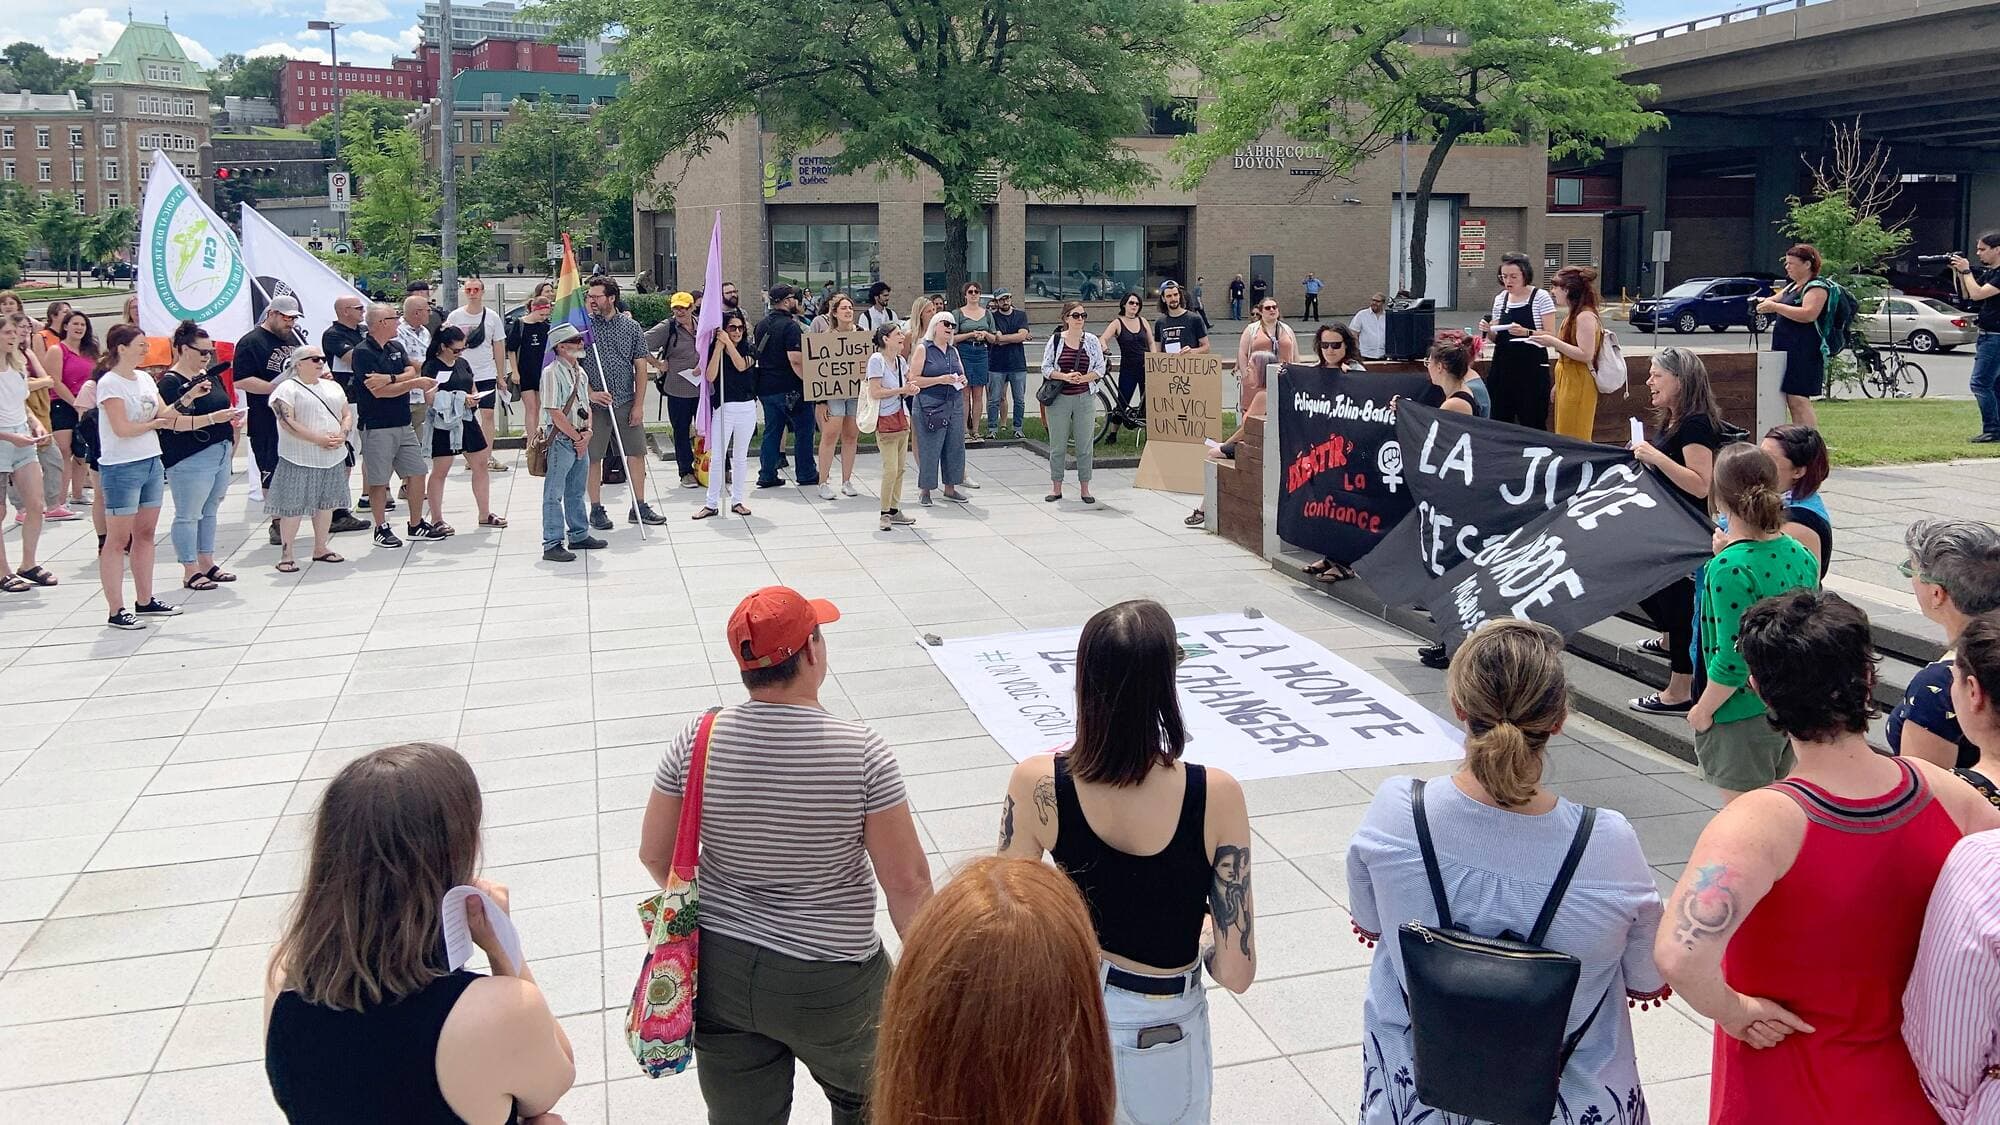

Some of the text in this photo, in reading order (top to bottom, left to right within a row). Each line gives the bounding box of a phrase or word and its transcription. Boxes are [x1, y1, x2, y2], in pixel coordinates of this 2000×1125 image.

[799, 166, 809, 175] DE
[1233, 157, 1286, 169] DOYON
[799, 176, 828, 185] Québec
[806, 337, 876, 360] La Justi
[818, 361, 855, 377] C'EST
[1146, 355, 1218, 375] INGÉNIEUR
[1168, 382, 1191, 395] PAS
[1172, 375, 1190, 385] OU
[1153, 397, 1217, 420] UN VIOL
[1155, 418, 1216, 440] UN VIOL
[1418, 419, 1474, 486] LA
[1344, 472, 1367, 492] La
[1304, 495, 1384, 534] confiance
[1204, 627, 1425, 740] LA HONTE
[1174, 664, 1330, 754] CHANGER
